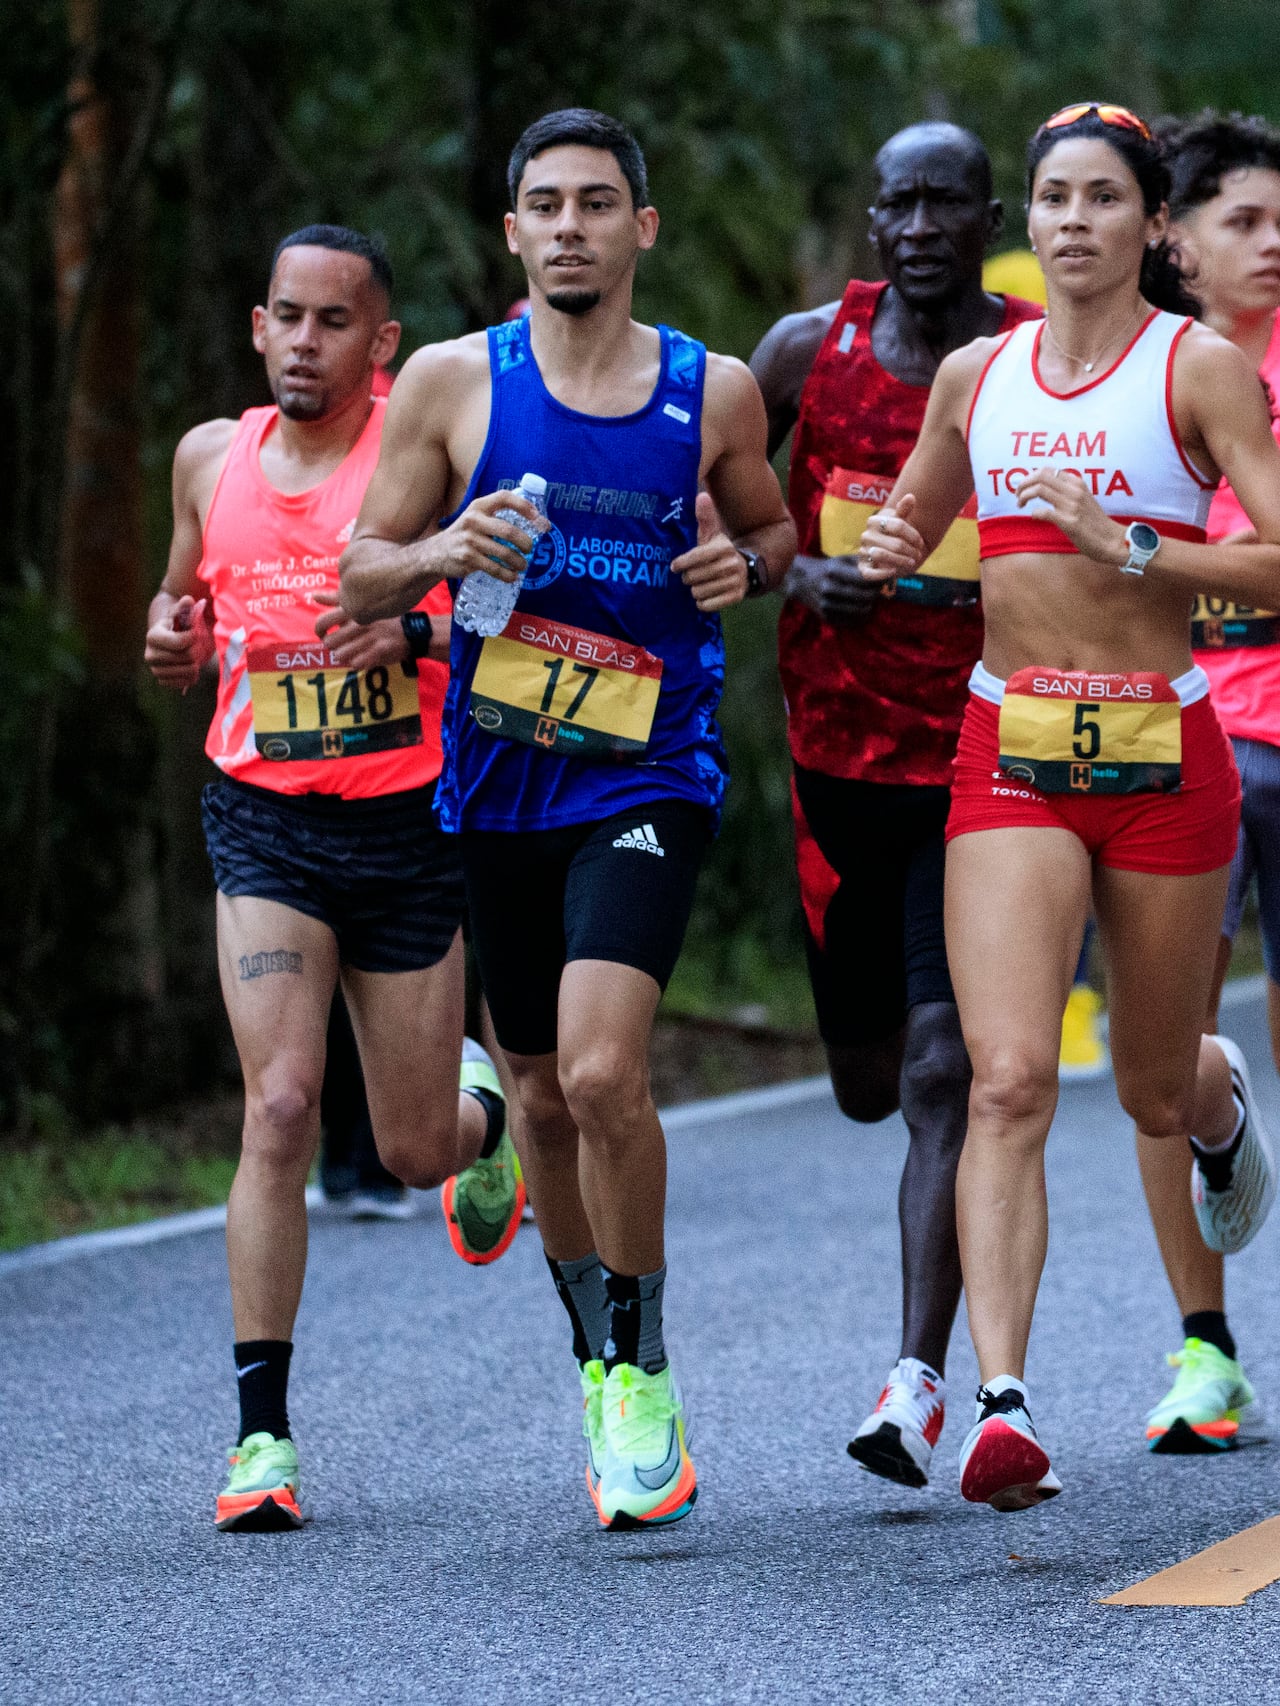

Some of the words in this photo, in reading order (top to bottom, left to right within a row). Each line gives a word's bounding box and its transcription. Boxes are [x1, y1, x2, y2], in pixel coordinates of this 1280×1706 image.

[1010, 430, 1107, 457] TEAM
[987, 467, 1134, 496] TOTA
[231, 563, 250, 577] Dr.
[252, 559, 283, 574] José
[286, 556, 299, 570] J.
[302, 554, 342, 569] Castr
[252, 572, 327, 592] URÓLOGO
[519, 625, 572, 653] SAN
[574, 641, 636, 669] BLAS
[275, 651, 325, 669] SAN
[277, 665, 394, 729] 1148
[540, 657, 600, 721] 17
[1033, 677, 1082, 697] SAN
[1087, 681, 1153, 699] BLAS
[558, 727, 585, 743] hello
[1072, 703, 1101, 760] 5
[1092, 768, 1120, 779] hello
[612, 838, 664, 857] adidas
